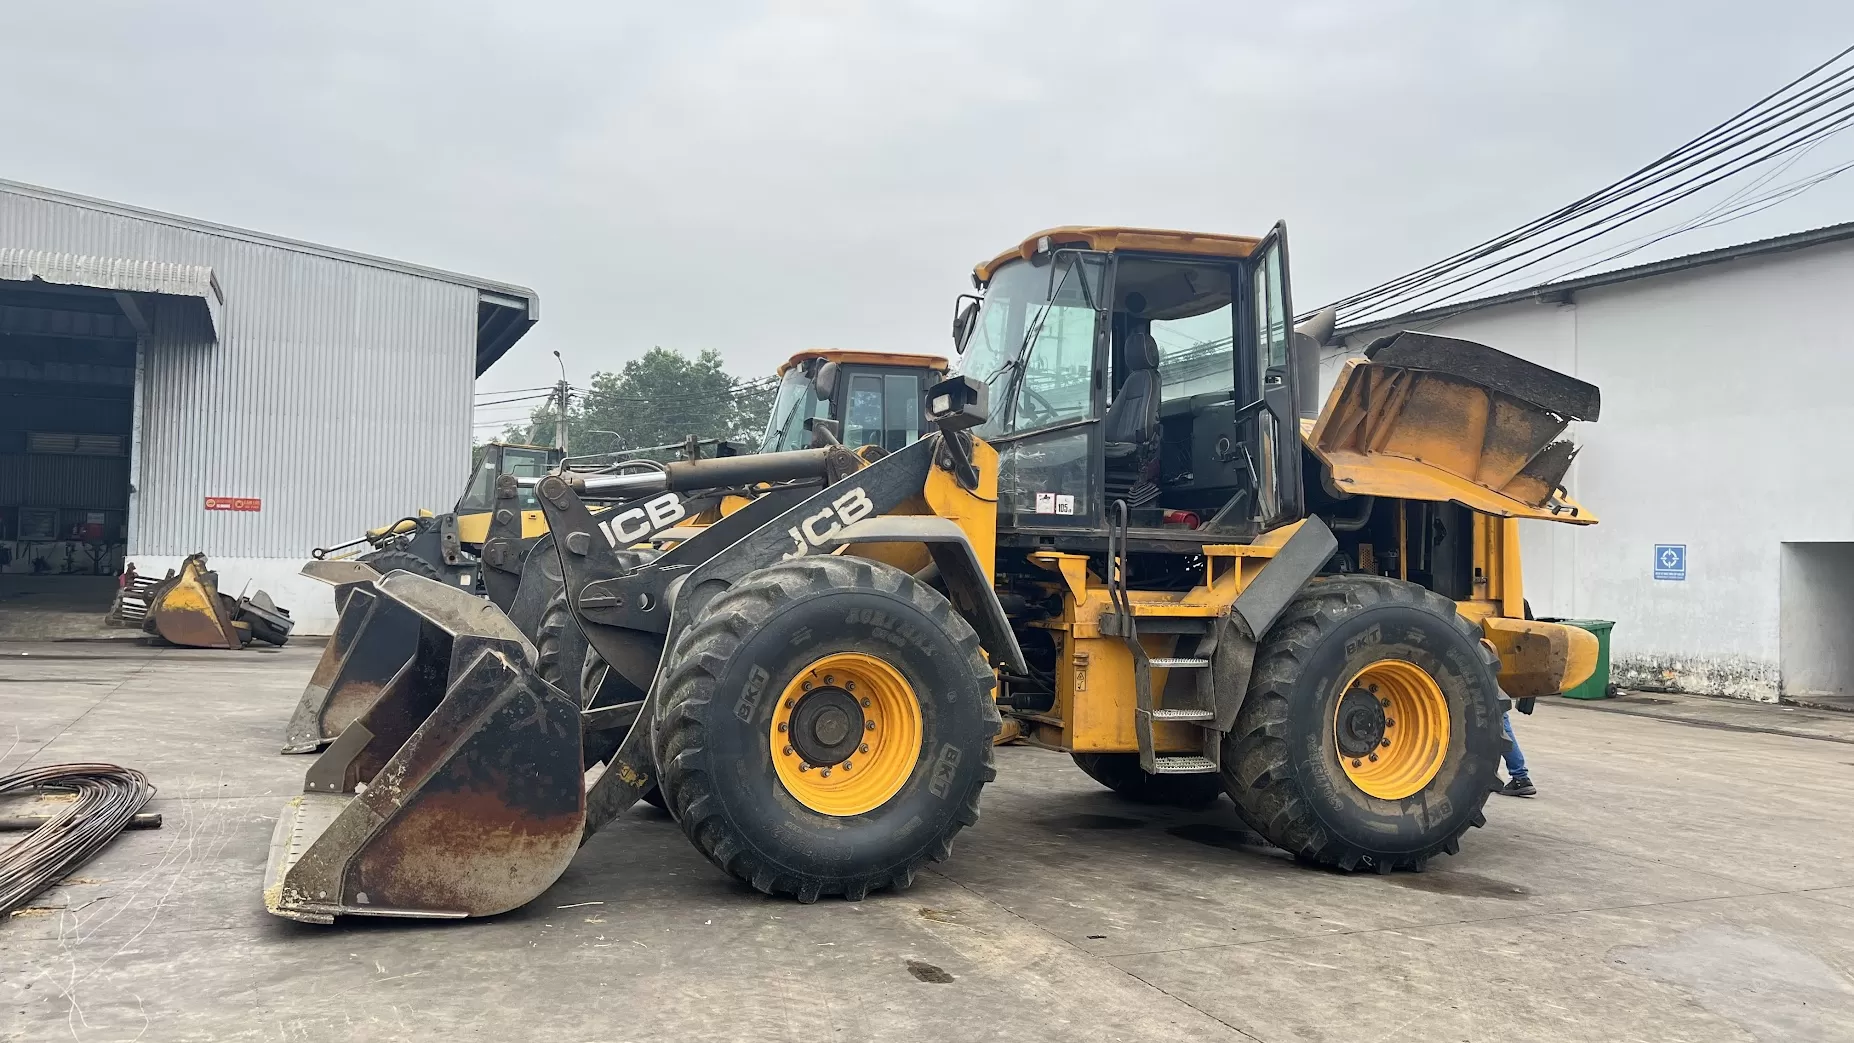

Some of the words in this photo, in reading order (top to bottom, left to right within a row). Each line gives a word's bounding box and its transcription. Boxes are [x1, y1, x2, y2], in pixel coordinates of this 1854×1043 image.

[782, 486, 874, 560] JCB
[1345, 626, 1380, 658] BKT
[735, 666, 767, 722] BKT
[932, 745, 960, 799] BKT
